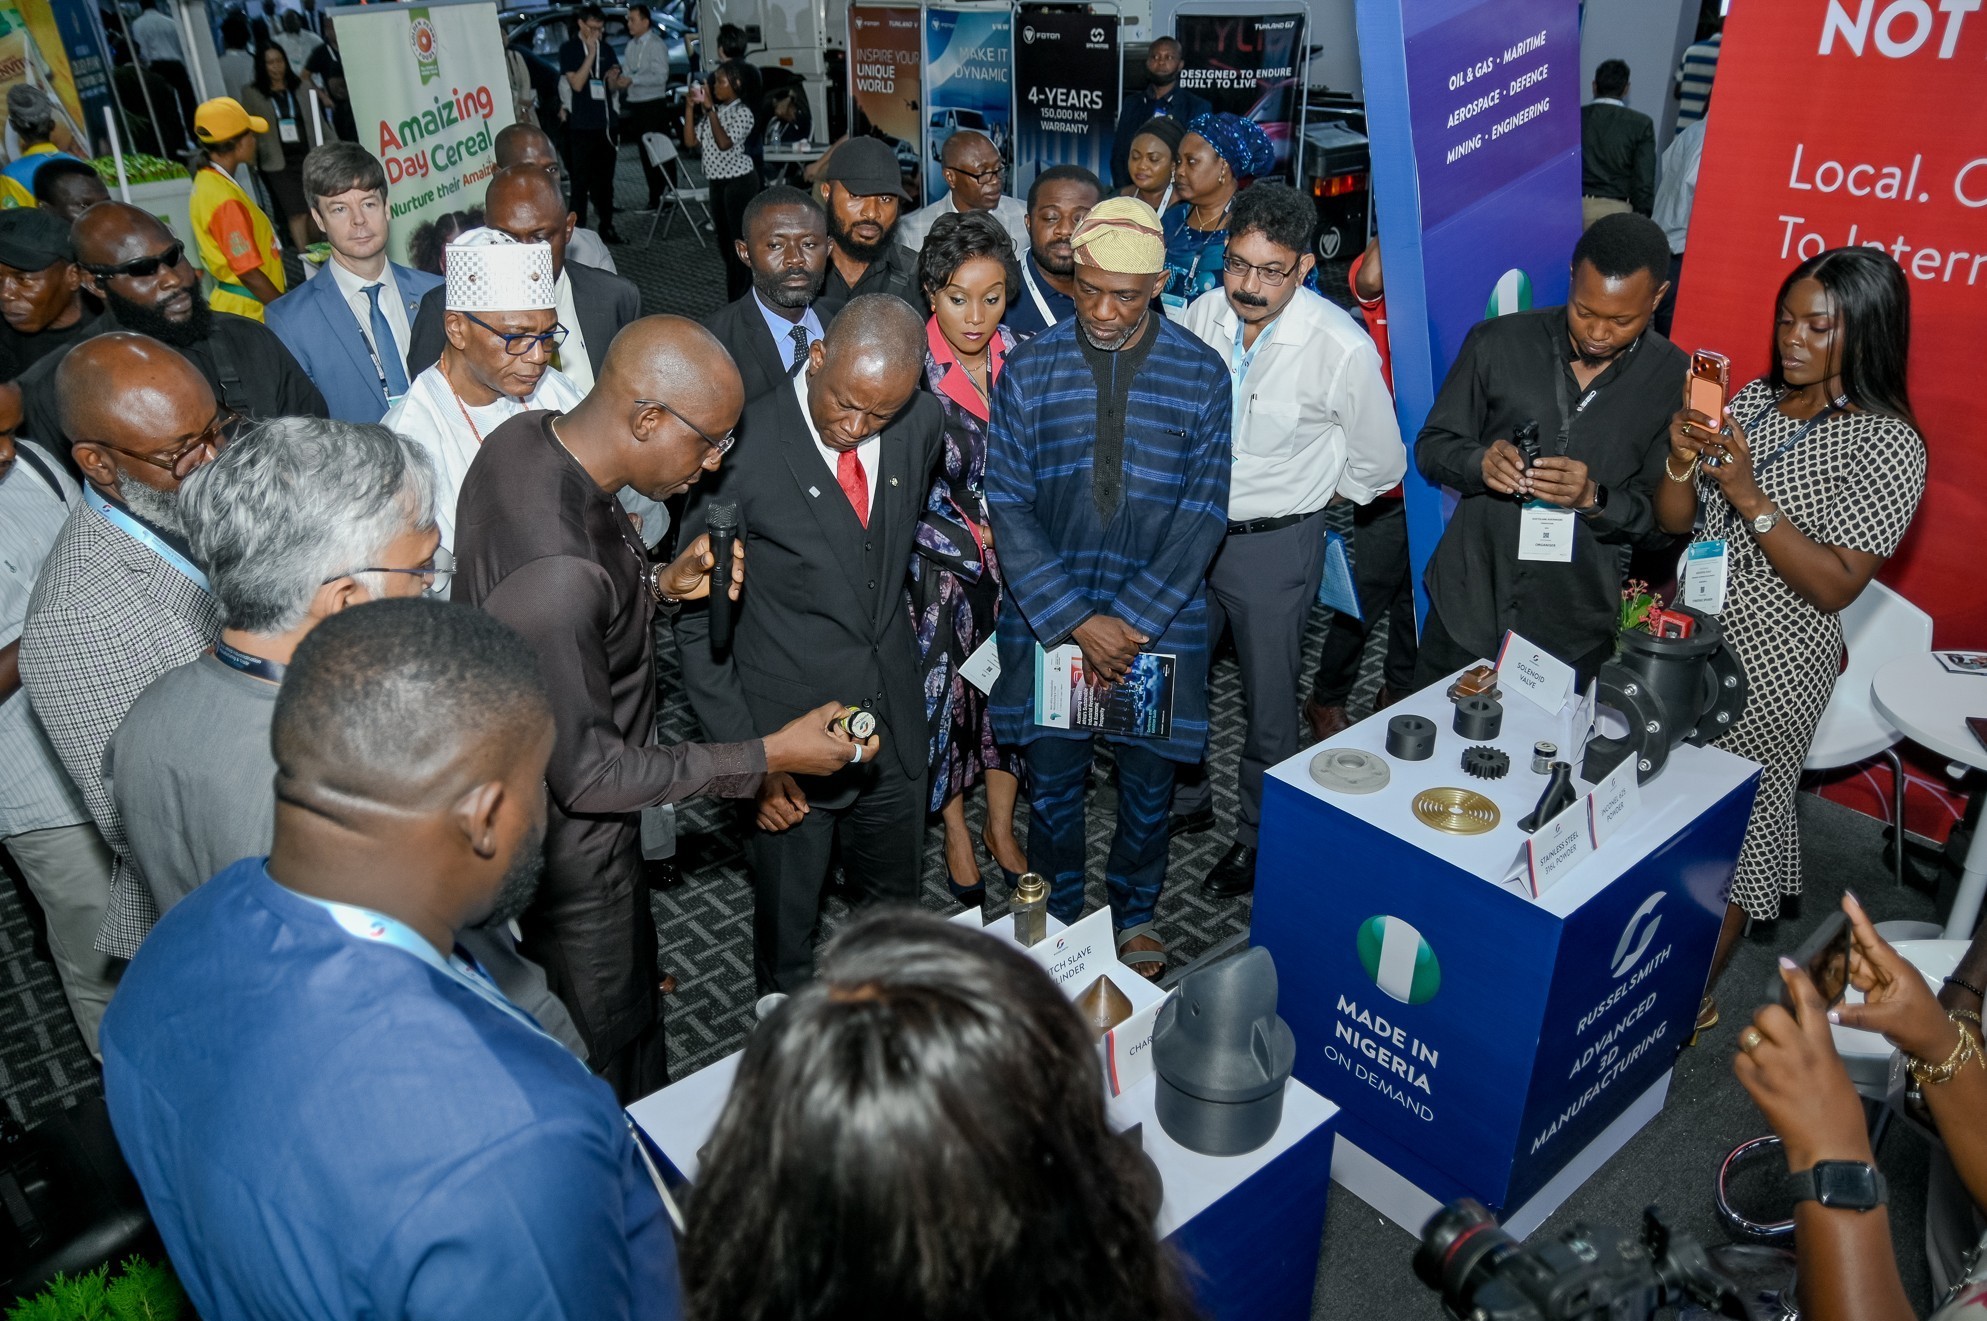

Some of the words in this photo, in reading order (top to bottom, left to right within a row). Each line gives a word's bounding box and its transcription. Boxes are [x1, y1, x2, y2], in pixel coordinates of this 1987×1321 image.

[1817, 0, 1982, 59] NOT
[856, 49, 893, 64] INSPIRE
[895, 50, 920, 65] YOUR
[959, 47, 995, 62] MAKE
[997, 48, 1009, 63] IT
[1448, 71, 1465, 91] OIL
[1466, 67, 1474, 83] &
[1475, 57, 1493, 78] GAS
[1503, 30, 1547, 64] MARITIME
[857, 63, 895, 79] UNIQUE
[954, 66, 1008, 83] DYNAMIC
[1180, 69, 1237, 79] DESIGNED
[1240, 69, 1254, 78] TO
[1256, 67, 1292, 78] ENDURE
[1180, 79, 1213, 88] BUILT
[1216, 79, 1231, 88] TO
[1233, 79, 1257, 88] LIVE
[856, 79, 895, 94] WORLD
[1028, 86, 1103, 109] 4-YEARS
[1447, 89, 1500, 129] AEROSPACE
[1509, 64, 1549, 96] DEFENCE
[380, 85, 494, 158] Amaizing
[1041, 107, 1073, 120] 150,000
[1074, 110, 1088, 121] KM
[1041, 120, 1089, 134] WARRANTY
[1446, 133, 1482, 165] MINING
[1491, 97, 1550, 140] ENGINEERING
[385, 150, 429, 185] Day
[431, 120, 493, 172] Cereal
[1788, 143, 1929, 203] Local.
[390, 190, 435, 219] Nurture
[436, 176, 460, 199] their
[1778, 214, 1826, 262] To
[1517, 662, 1545, 683] SOLENOID
[1520, 674, 1537, 689] VALVE
[1601, 796, 1619, 816] INCONEL
[1606, 801, 1624, 822] POWDER
[1540, 840, 1565, 867] STAINLESS
[1564, 831, 1579, 846] STEEL
[1545, 862, 1556, 875] 316L
[1556, 844, 1577, 865] POWDER
[1067, 945, 1092, 965] SLAVE
[1055, 963, 1085, 985] LINDER
[1576, 944, 1672, 1036] RUSSELSMITH
[1336, 994, 1407, 1049] MADE
[1411, 1038, 1439, 1069] IN
[1569, 992, 1657, 1080] ADVANCED
[1335, 1020, 1431, 1095] NIGERIA
[1598, 1045, 1620, 1074] 3D
[1324, 1045, 1351, 1071] ON
[1355, 1063, 1434, 1121] DEMAND
[1531, 1020, 1667, 1155] MANUFACTURING
